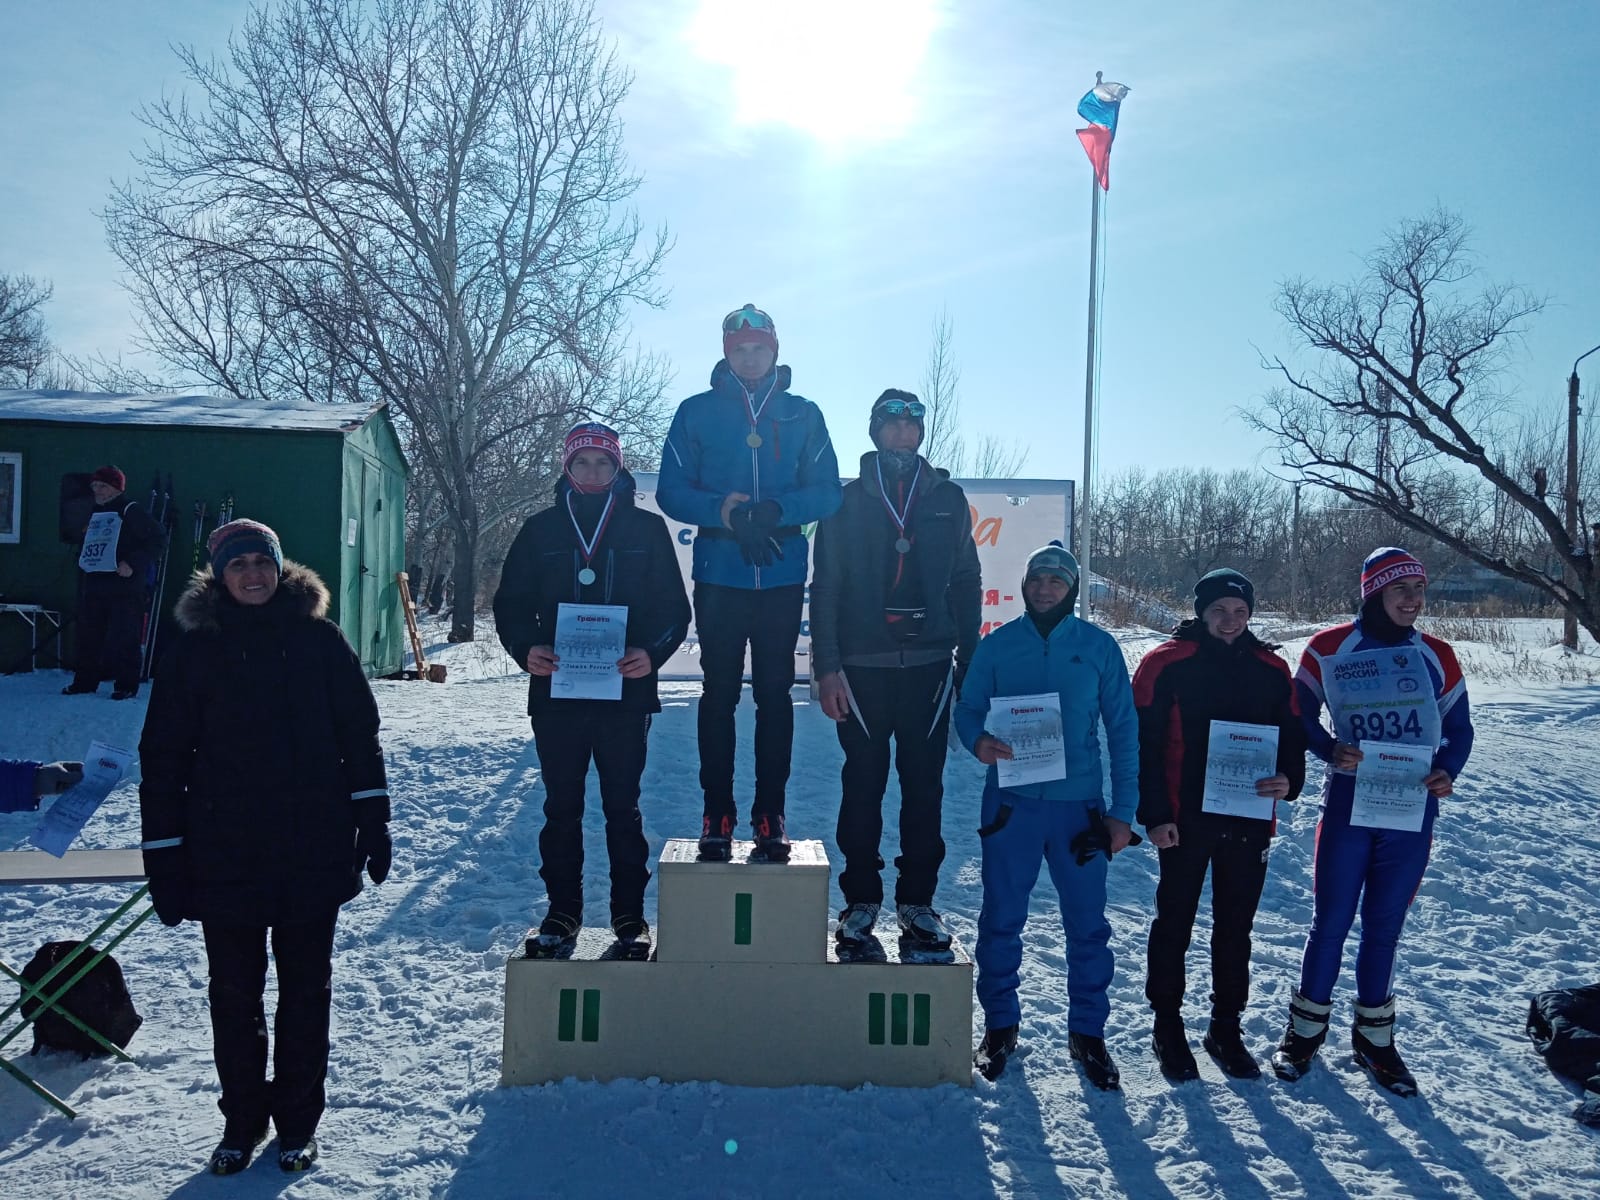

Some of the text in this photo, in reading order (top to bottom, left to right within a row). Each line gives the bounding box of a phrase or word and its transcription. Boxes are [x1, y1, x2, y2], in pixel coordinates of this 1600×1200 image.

[1373, 565, 1423, 590] ЛЫЖНЯ
[1333, 660, 1377, 674] ЛЫЖНЯ
[1335, 669, 1380, 680] РОССИИ
[1349, 708, 1423, 740] 8934
[558, 988, 601, 1042] II
[868, 992, 931, 1046] III
